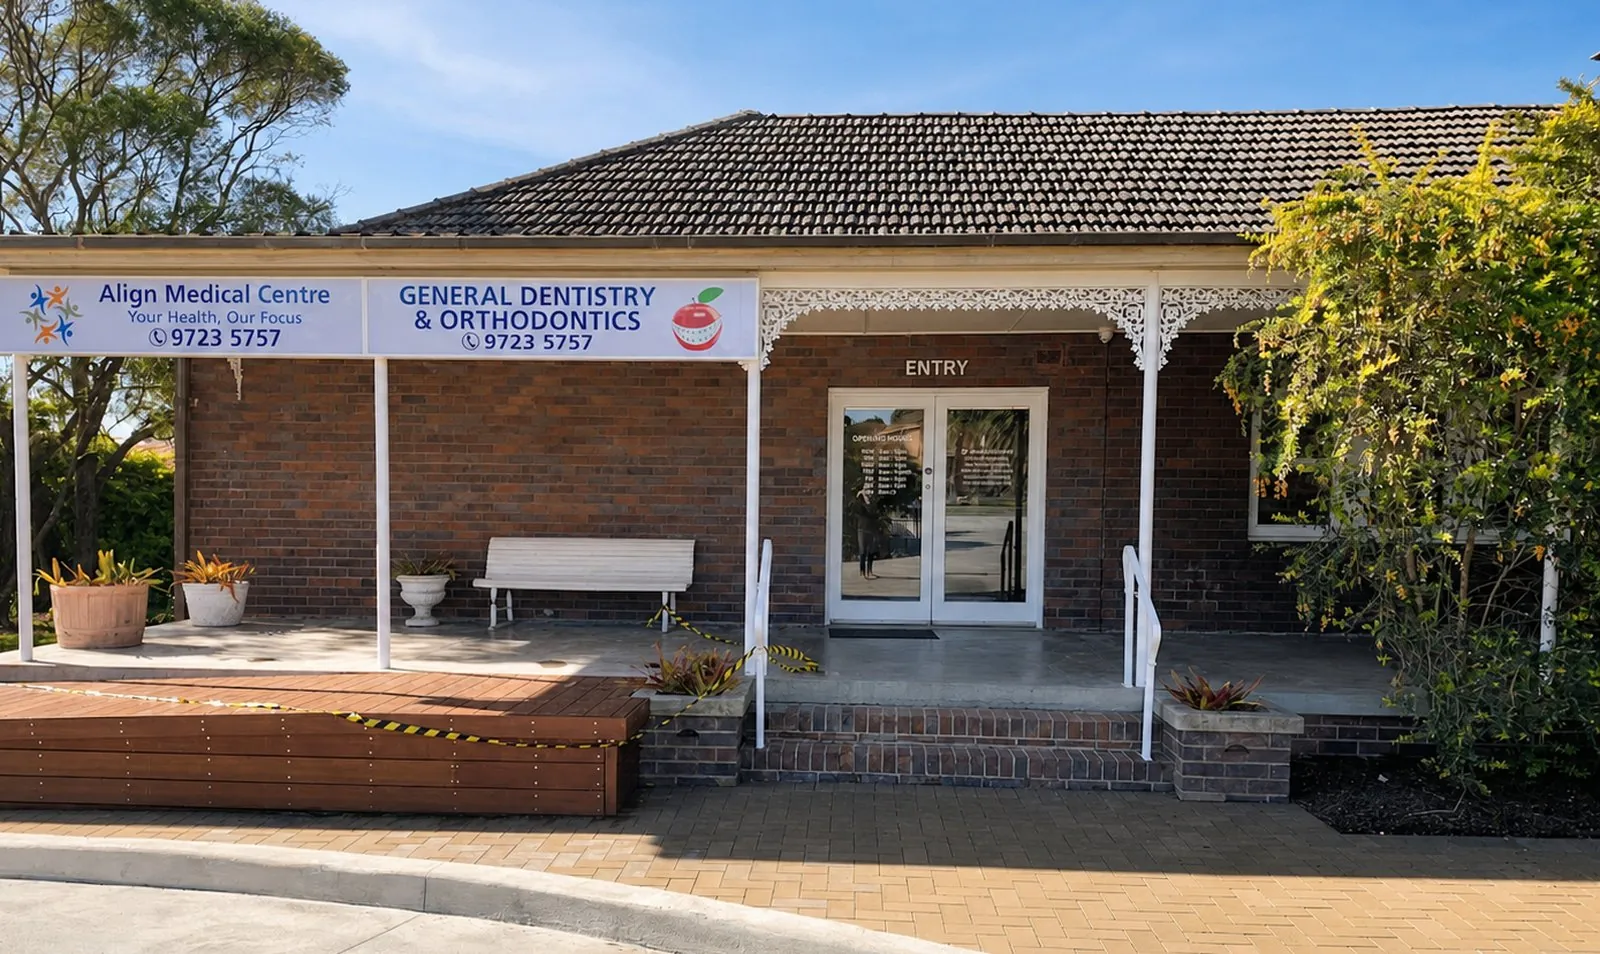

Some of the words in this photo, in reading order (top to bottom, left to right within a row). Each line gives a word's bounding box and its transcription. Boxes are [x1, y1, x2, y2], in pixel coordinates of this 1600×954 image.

[99, 283, 157, 308] Align
[165, 283, 250, 304] Medical
[258, 284, 330, 304] Centre
[399, 285, 513, 306] GENERAL
[520, 286, 656, 307] DENTISTRY
[127, 309, 163, 324] Your
[168, 309, 221, 326] Health,
[227, 310, 255, 325] Our
[260, 310, 303, 325] Focus
[414, 310, 432, 330] &
[439, 310, 641, 330] ORTHODONTICS
[171, 328, 222, 347] 9723
[230, 328, 281, 347] 5757
[484, 334, 535, 351] 9723
[543, 334, 593, 351] 5757
[905, 359, 969, 376] ENTRY
